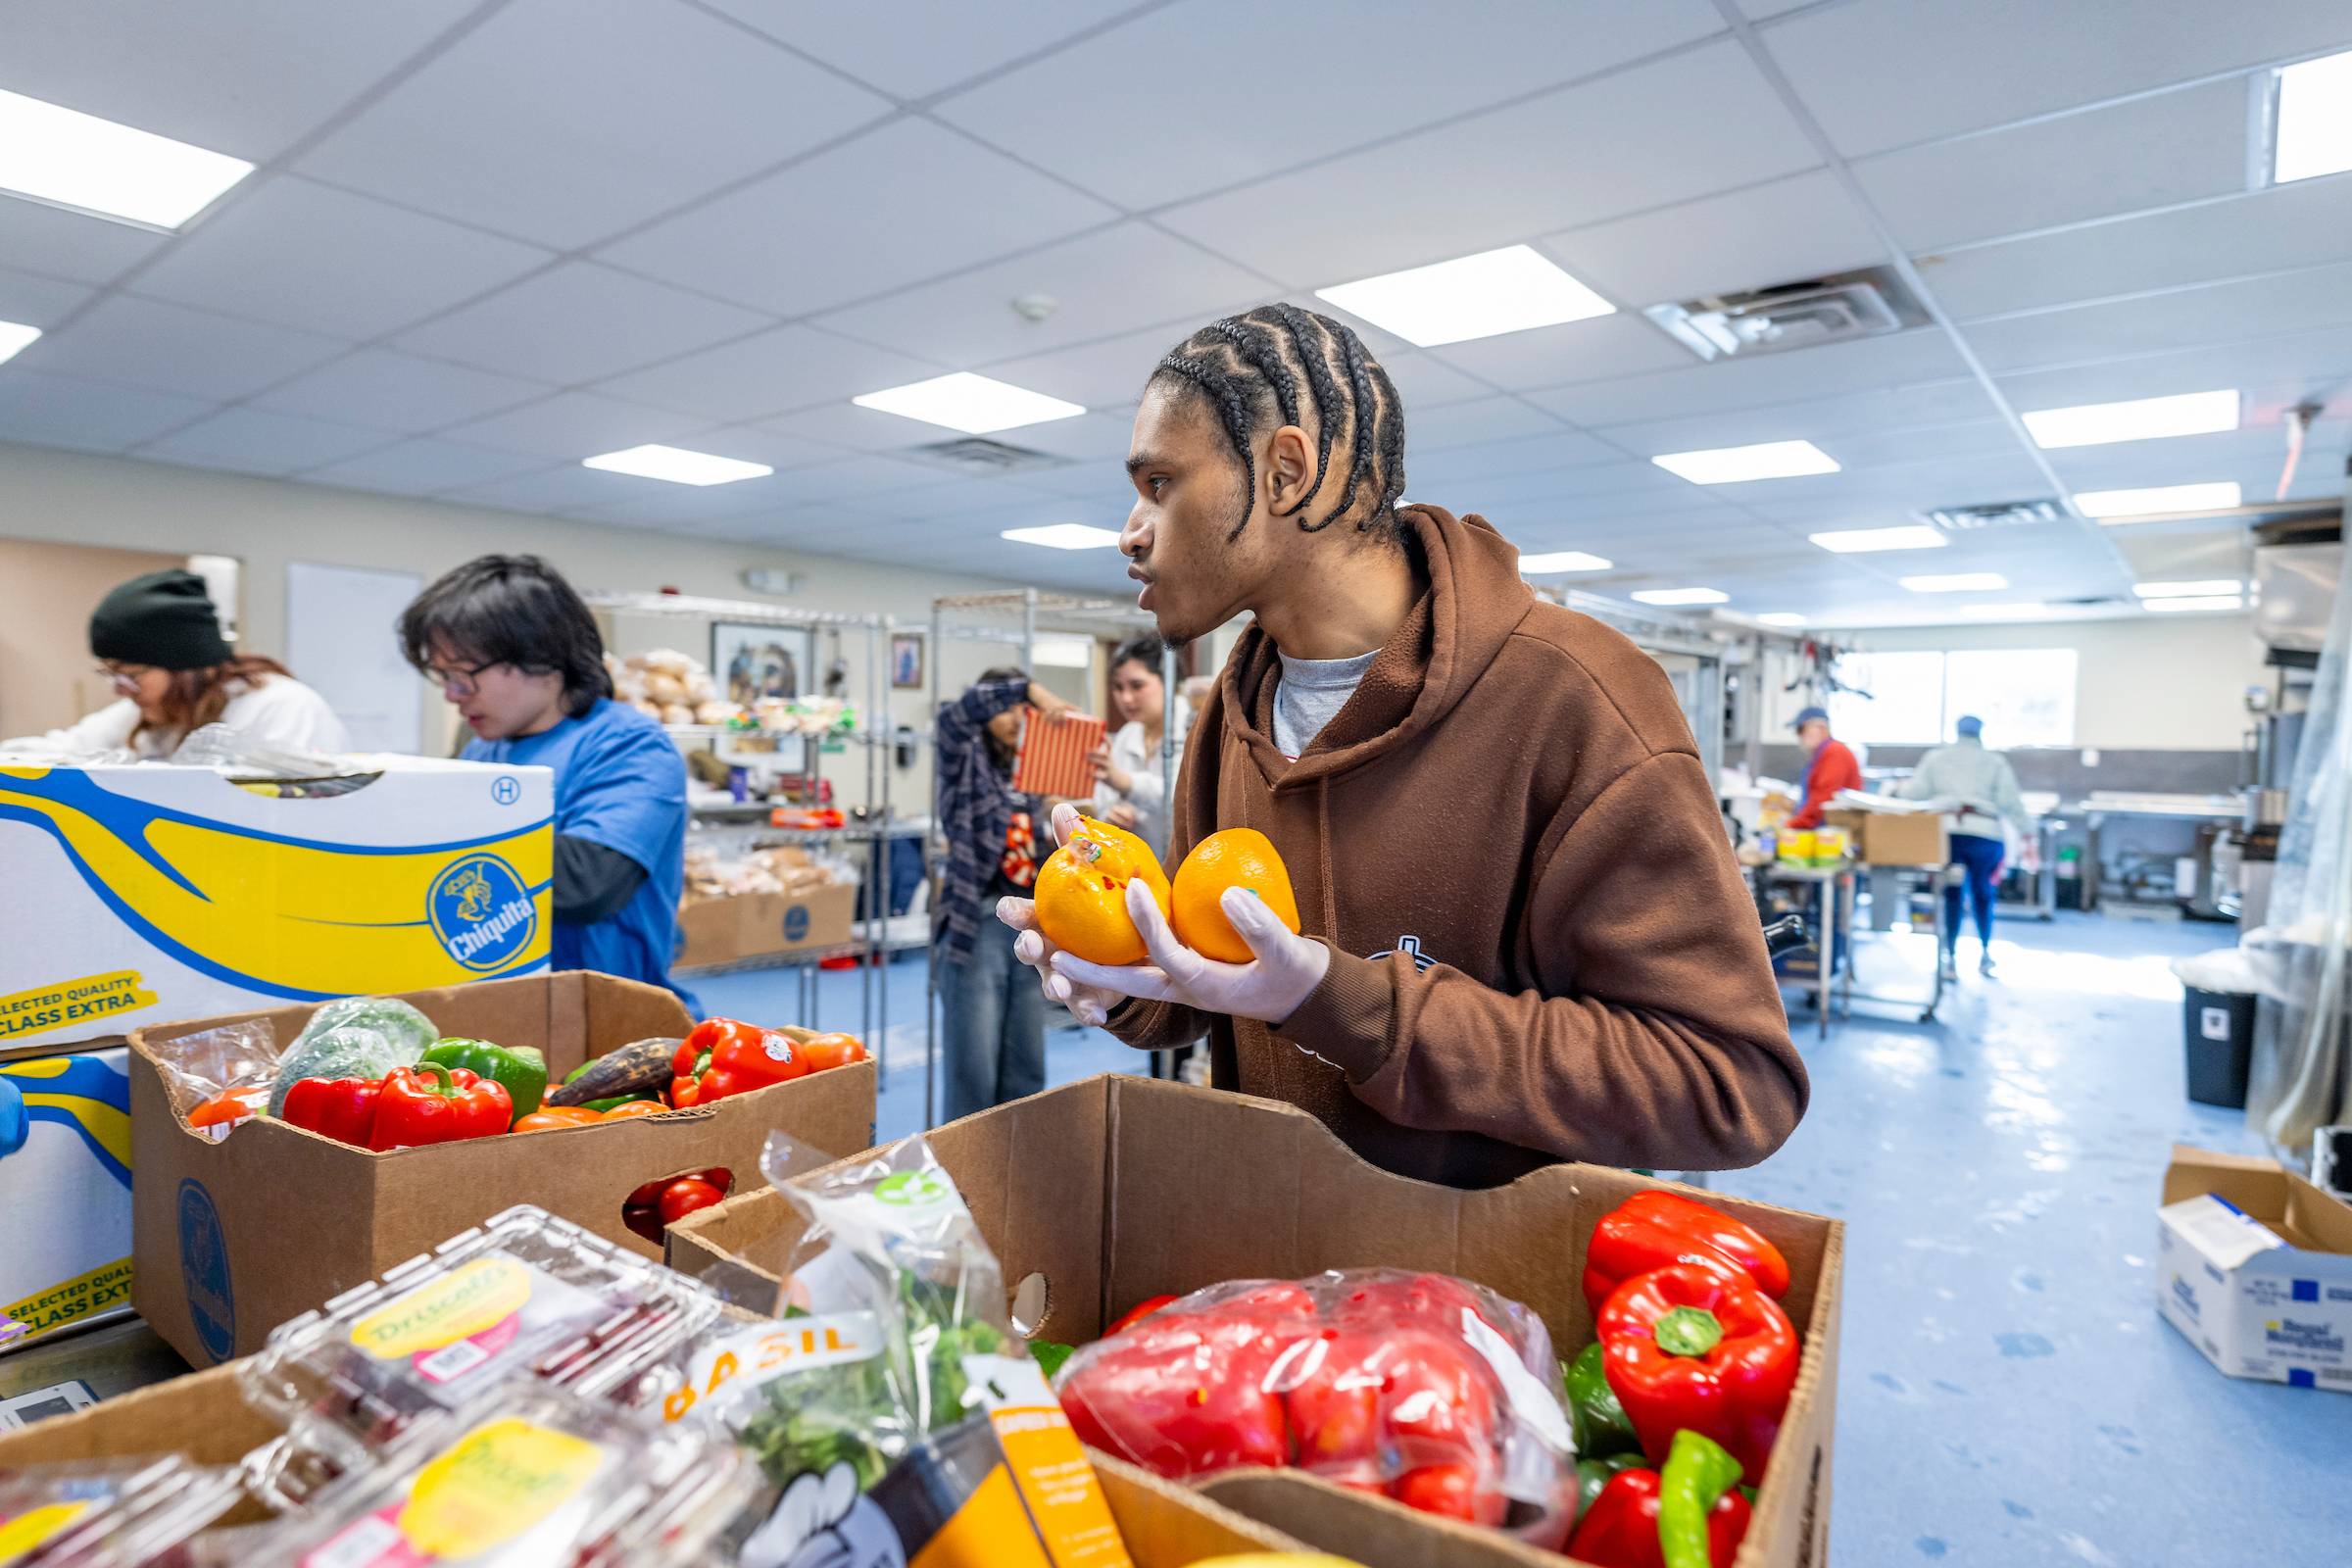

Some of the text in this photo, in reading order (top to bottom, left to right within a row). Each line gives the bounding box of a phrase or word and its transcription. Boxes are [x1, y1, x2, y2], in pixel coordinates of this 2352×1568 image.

[449, 898, 534, 961] Chiquita
[0, 977, 133, 1015] LECTED QUALITY
[67, 993, 136, 1019] EXTRA
[10, 1265, 133, 1320] SELECTED QUAL
[92, 1280, 131, 1305] EXT
